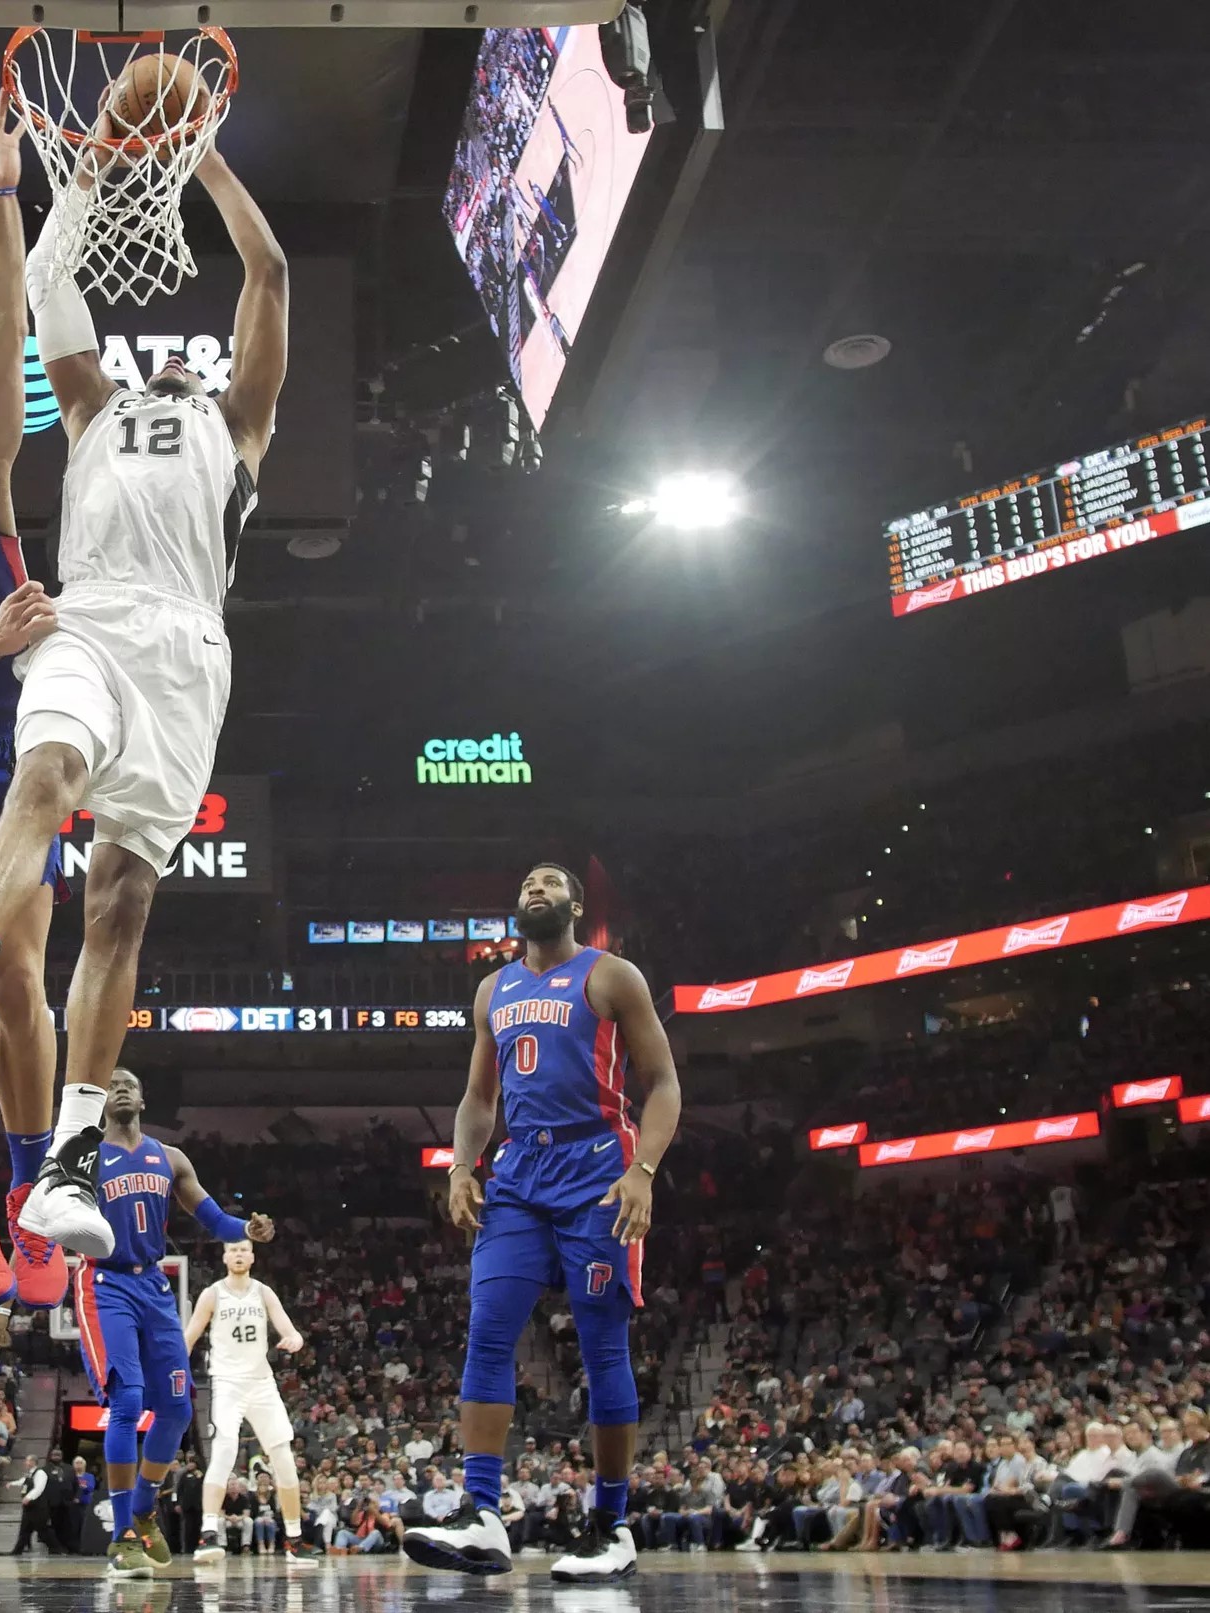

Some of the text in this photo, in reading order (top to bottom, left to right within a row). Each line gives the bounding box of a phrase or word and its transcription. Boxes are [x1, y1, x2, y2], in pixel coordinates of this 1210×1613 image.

[100, 335, 231, 392] AT&
[118, 417, 184, 456] 12
[961, 518, 1158, 595] THIS BUD'S FOR YOU.
[425, 732, 523, 761] credit
[417, 756, 532, 783] human
[242, 1008, 466, 1030] DET 31 F 3 FG 33%
[492, 999, 573, 1036] DETROIT
[516, 1035, 538, 1075] 0
[102, 1173, 170, 1203] DETROIT
[135, 1201, 147, 1233] 1
[220, 1306, 264, 1321] SPURS
[232, 1325, 257, 1342] 42
